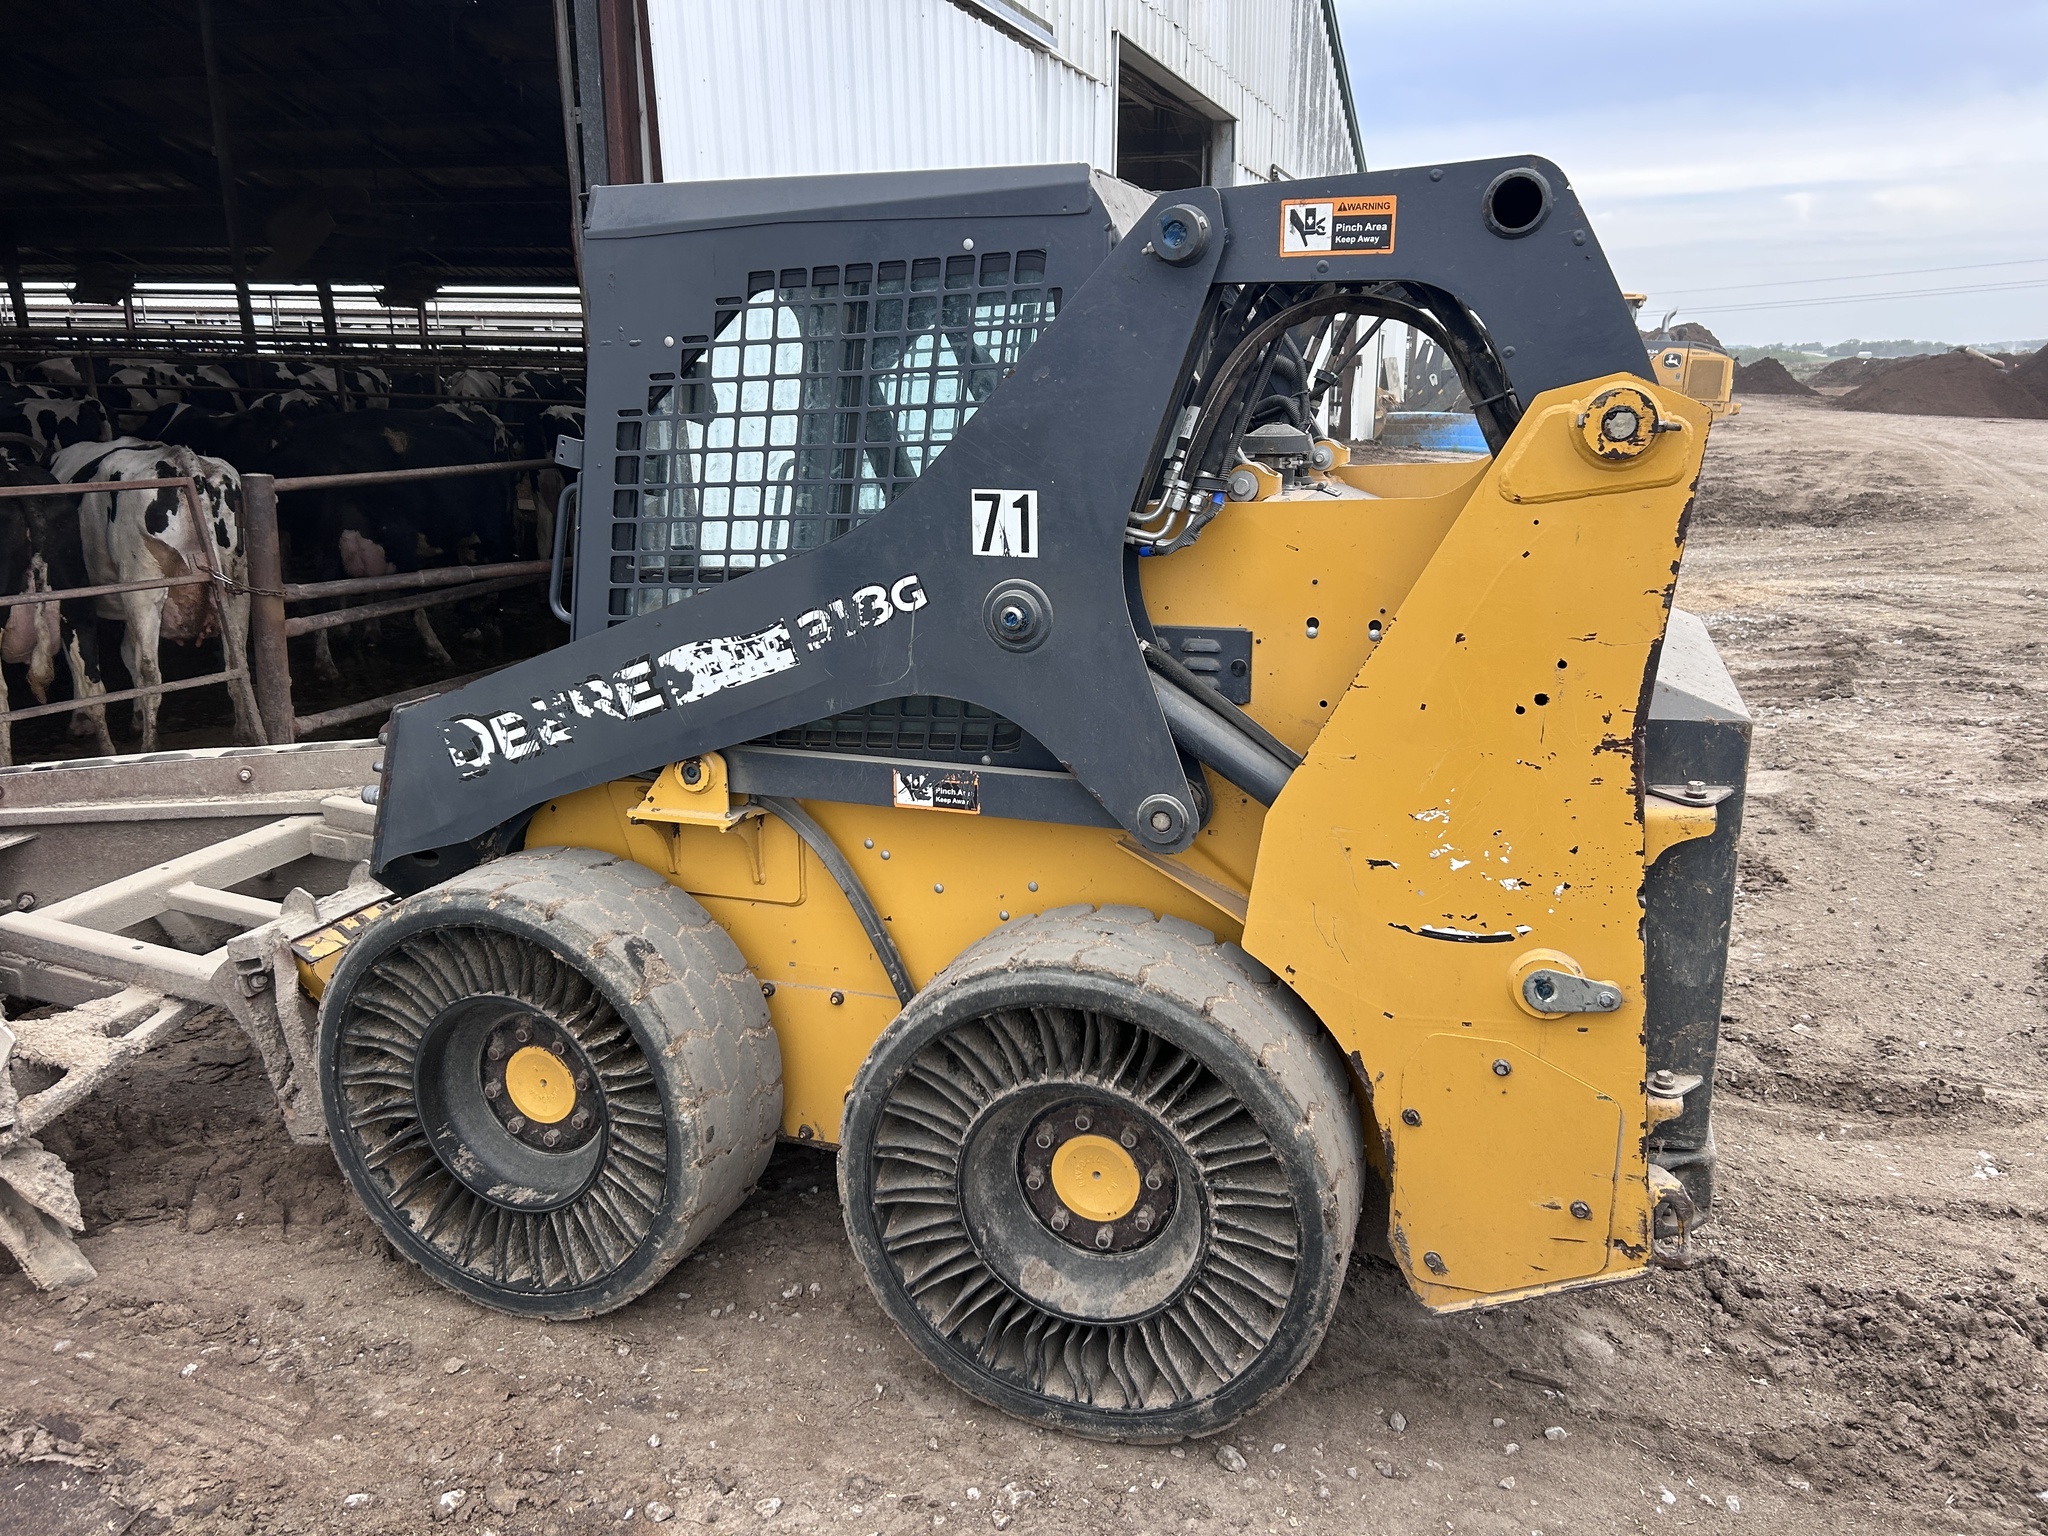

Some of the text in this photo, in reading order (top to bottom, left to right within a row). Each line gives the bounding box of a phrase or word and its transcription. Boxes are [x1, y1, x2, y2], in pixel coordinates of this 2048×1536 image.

[1347, 202, 1391, 211] WARNING
[1336, 222, 1388, 232] Pinch Area
[1335, 235, 1380, 245] Keep Away
[974, 493, 1030, 553] 71
[935, 787, 956, 796] Pinch
[935, 796, 951, 805] Keep
